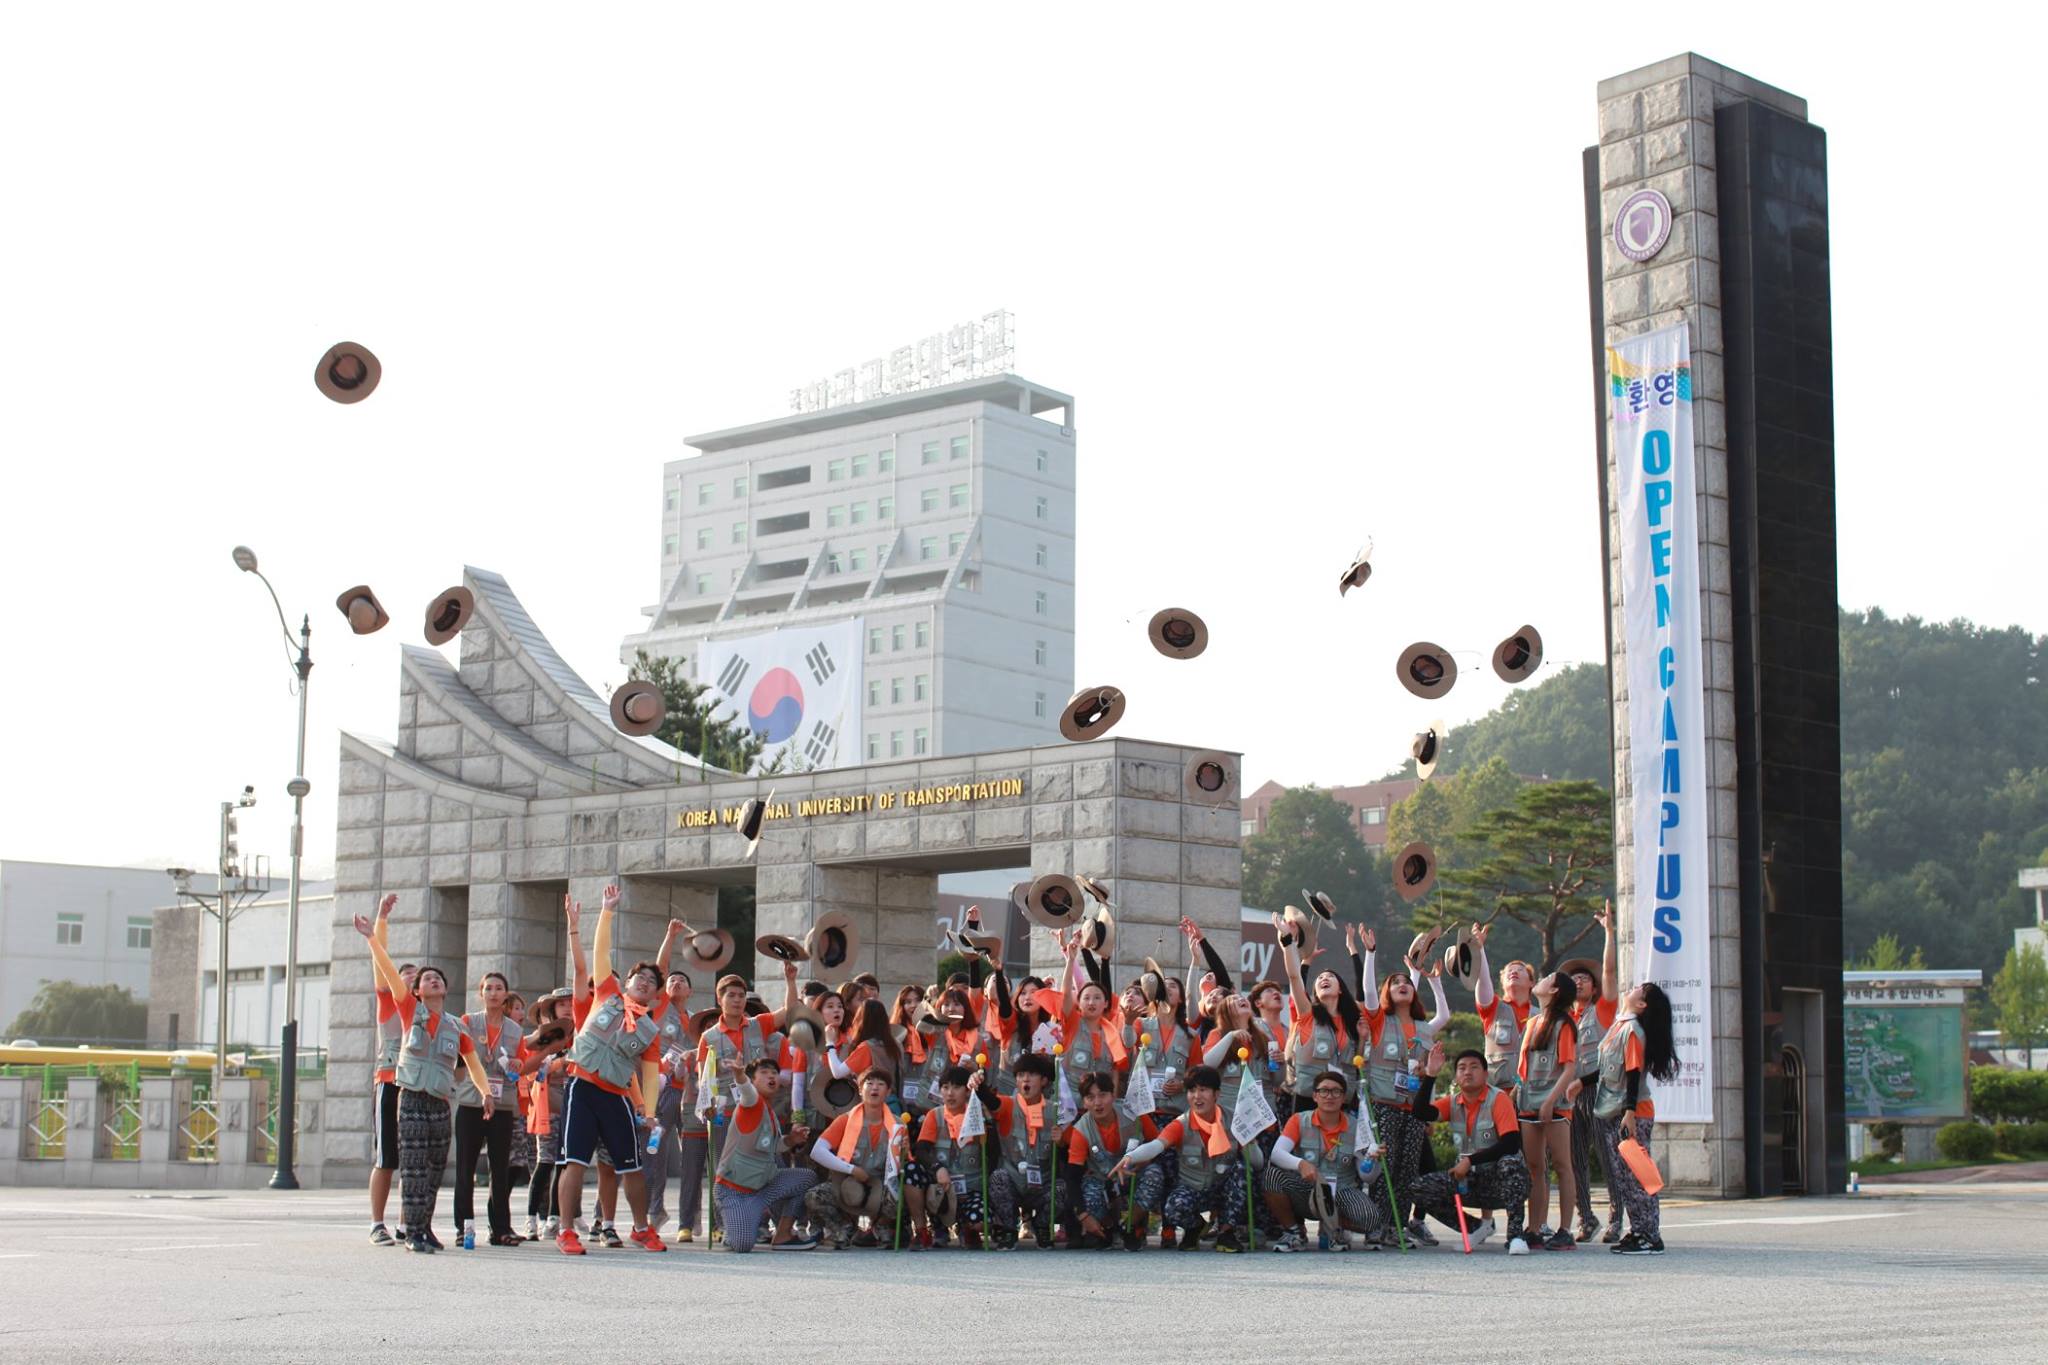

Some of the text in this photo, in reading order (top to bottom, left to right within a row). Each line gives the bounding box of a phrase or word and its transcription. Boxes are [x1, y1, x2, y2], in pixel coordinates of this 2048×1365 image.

[1642, 429, 1681, 954] OPEN CAMPUS
[678, 778, 1023, 828] KOREA NANAL UNIVERSITY OF TRANSPORTATION
[1844, 987, 1946, 1001] 대학교종합안내도
